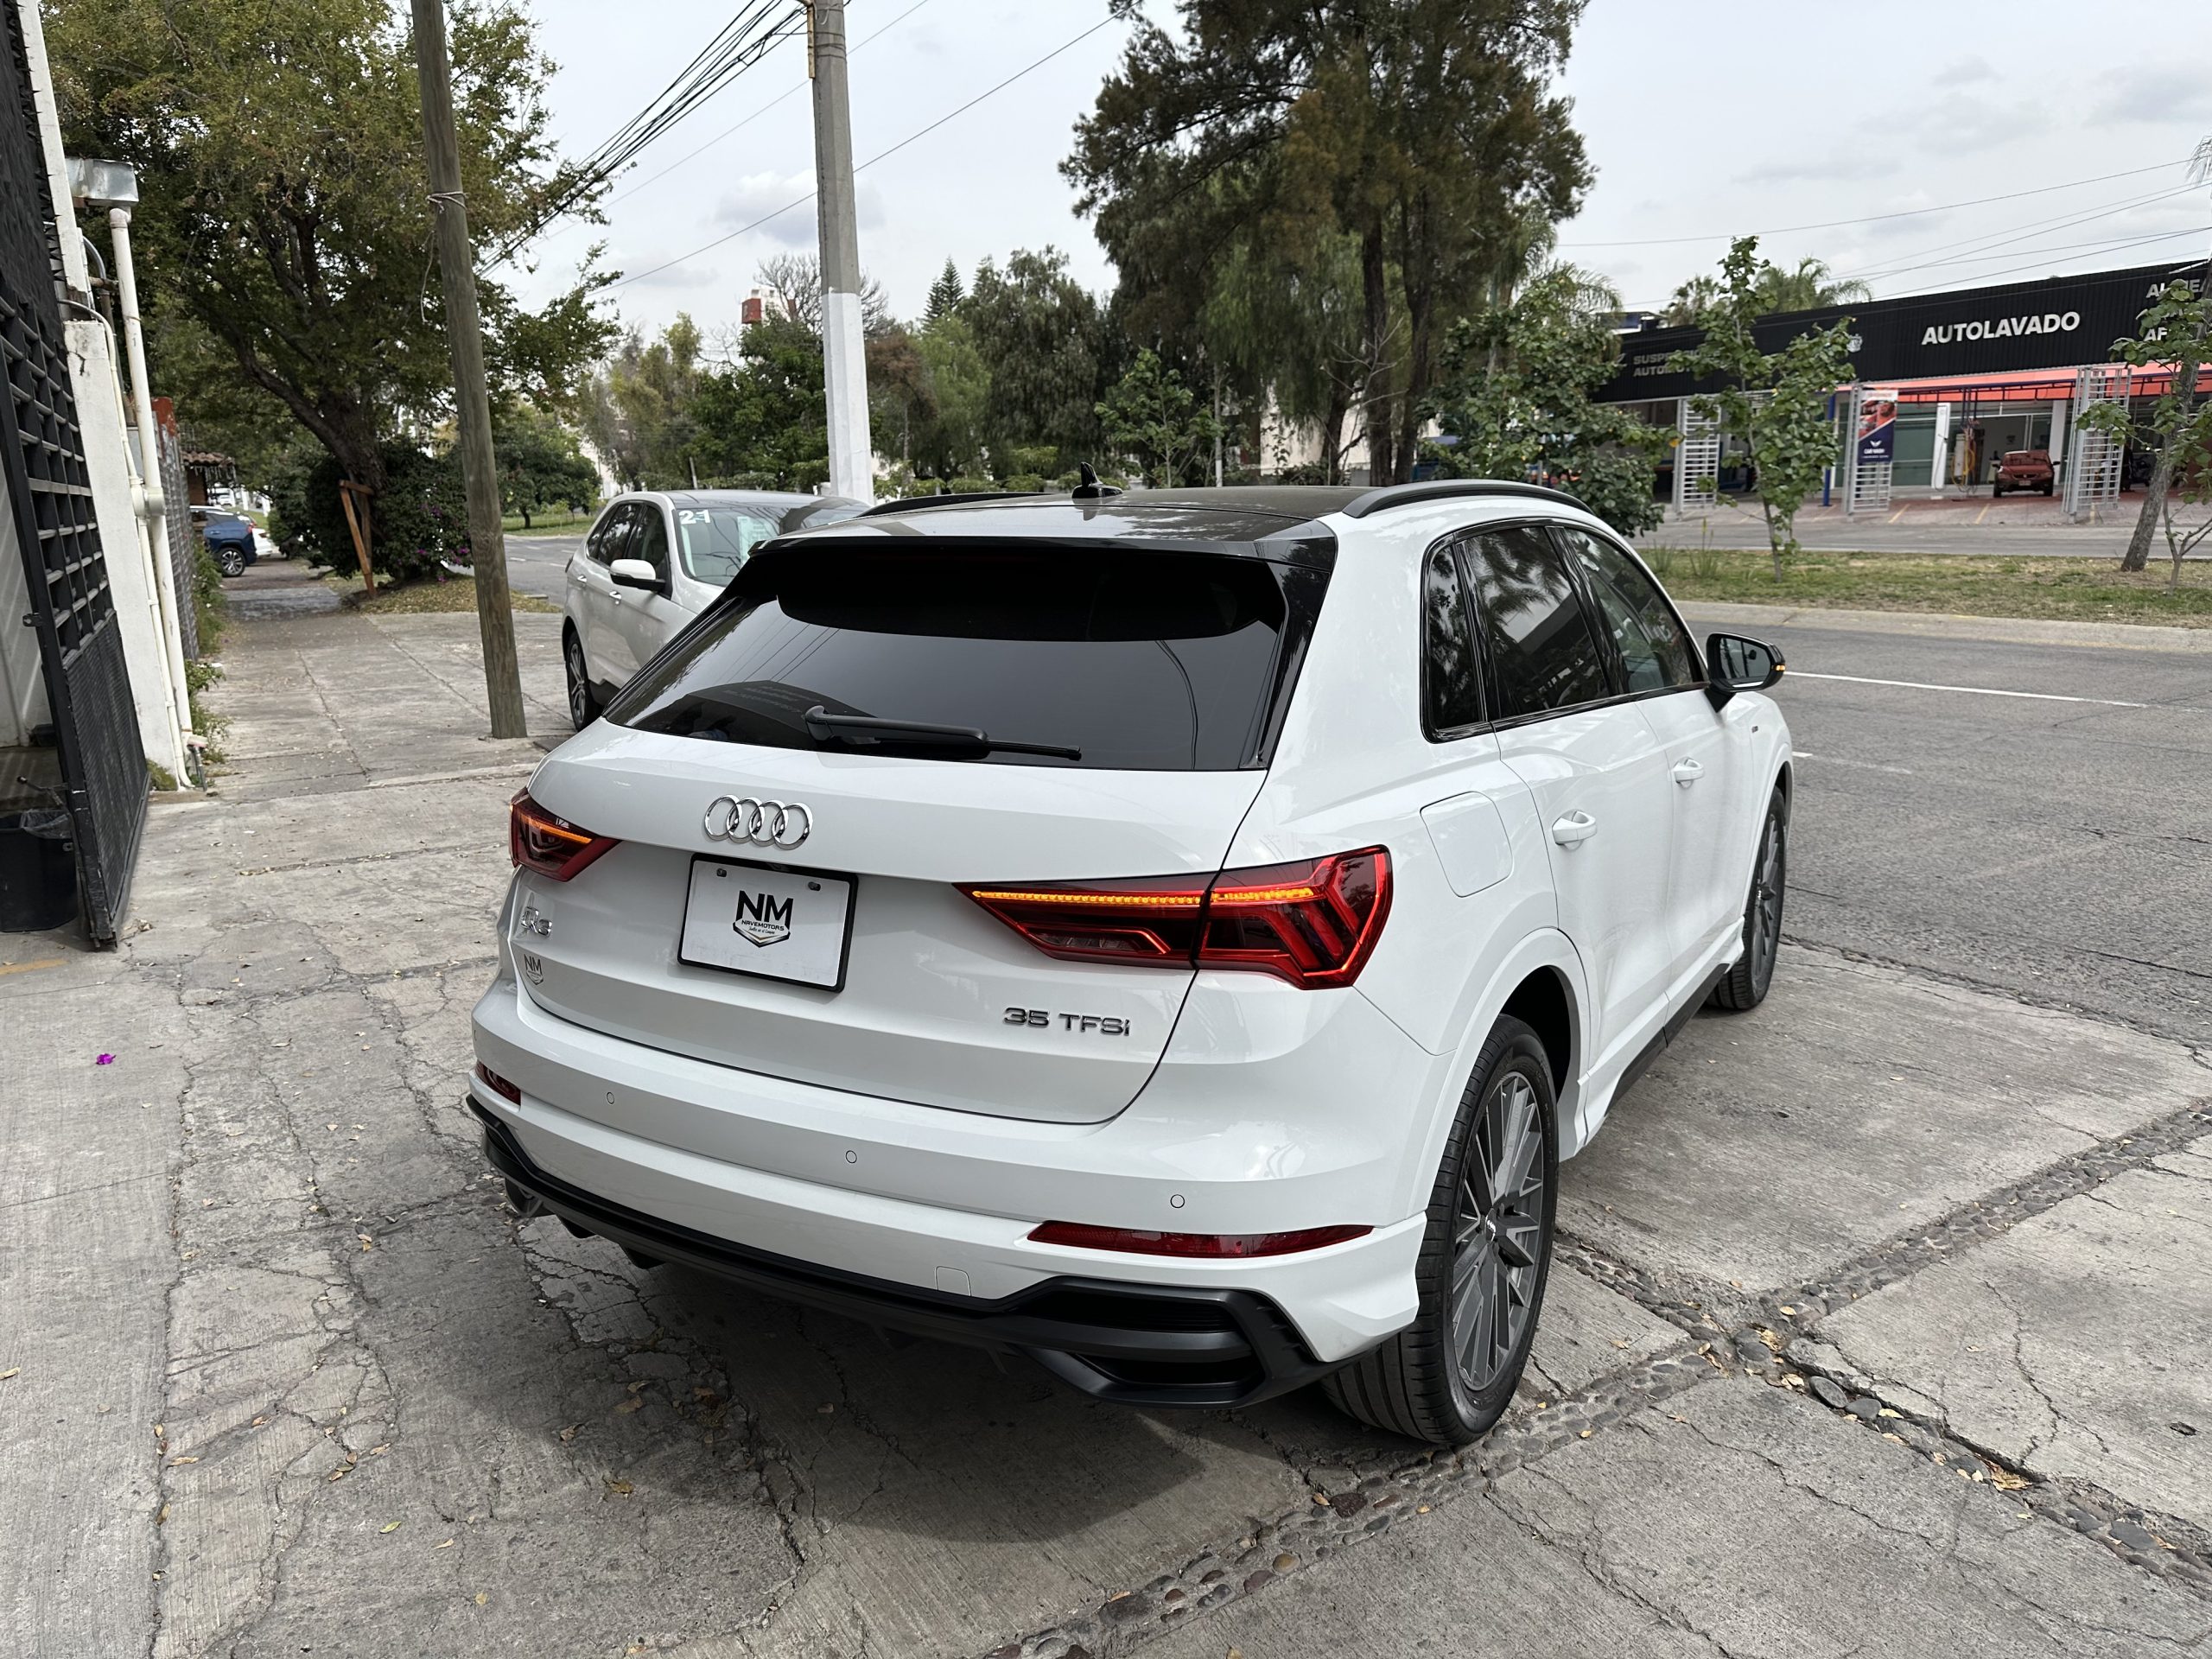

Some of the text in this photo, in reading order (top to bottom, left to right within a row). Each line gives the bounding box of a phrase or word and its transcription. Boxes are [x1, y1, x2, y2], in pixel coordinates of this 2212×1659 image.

[1921, 311, 2081, 346] AUTOLAVADO
[678, 509, 711, 524] 21
[735, 890, 794, 931] NM
[520, 906, 553, 938] Q3
[741, 919, 785, 931] NAVEMOTORS
[524, 953, 543, 975] NM
[1003, 1006, 1050, 1028] 35
